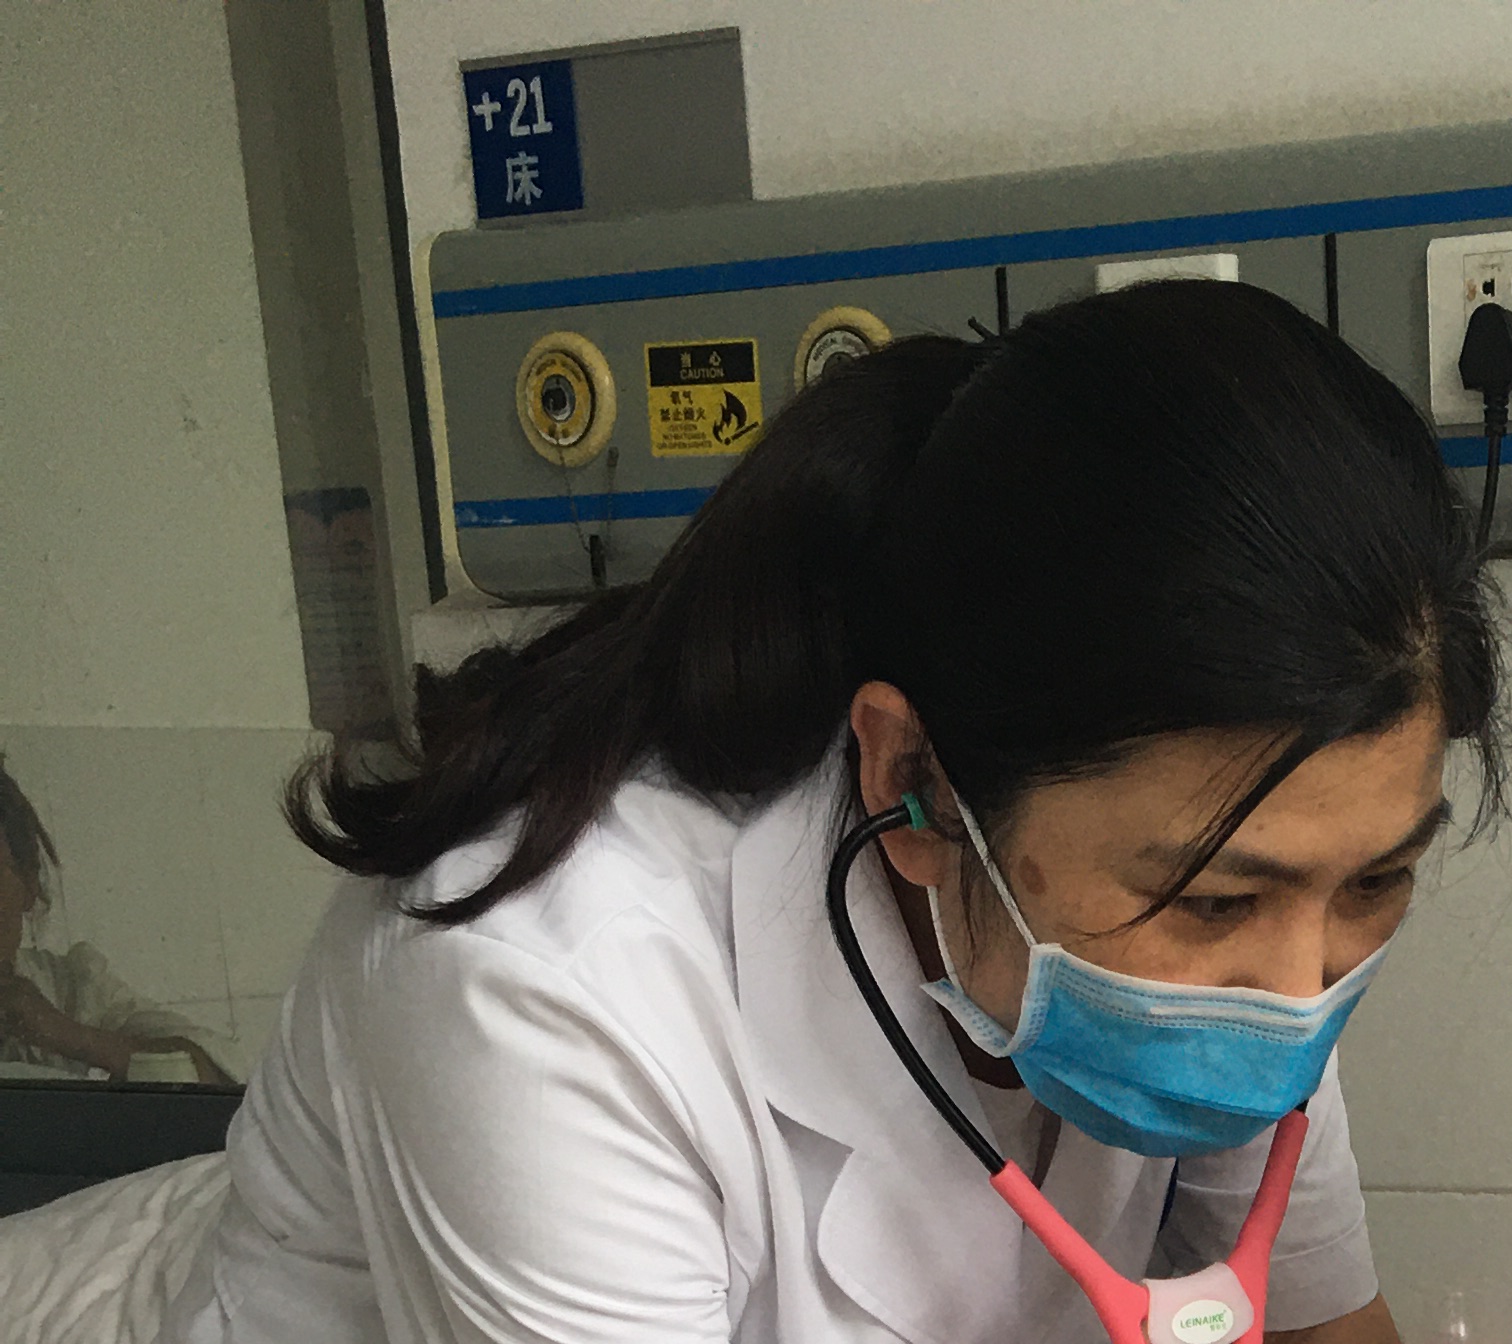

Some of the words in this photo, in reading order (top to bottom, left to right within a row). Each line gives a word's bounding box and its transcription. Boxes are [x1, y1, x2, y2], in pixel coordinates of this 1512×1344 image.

[506, 151, 543, 205] 床
[680, 367, 724, 380] CAUTION
[1180, 1312, 1225, 1329] LEINAIKE
